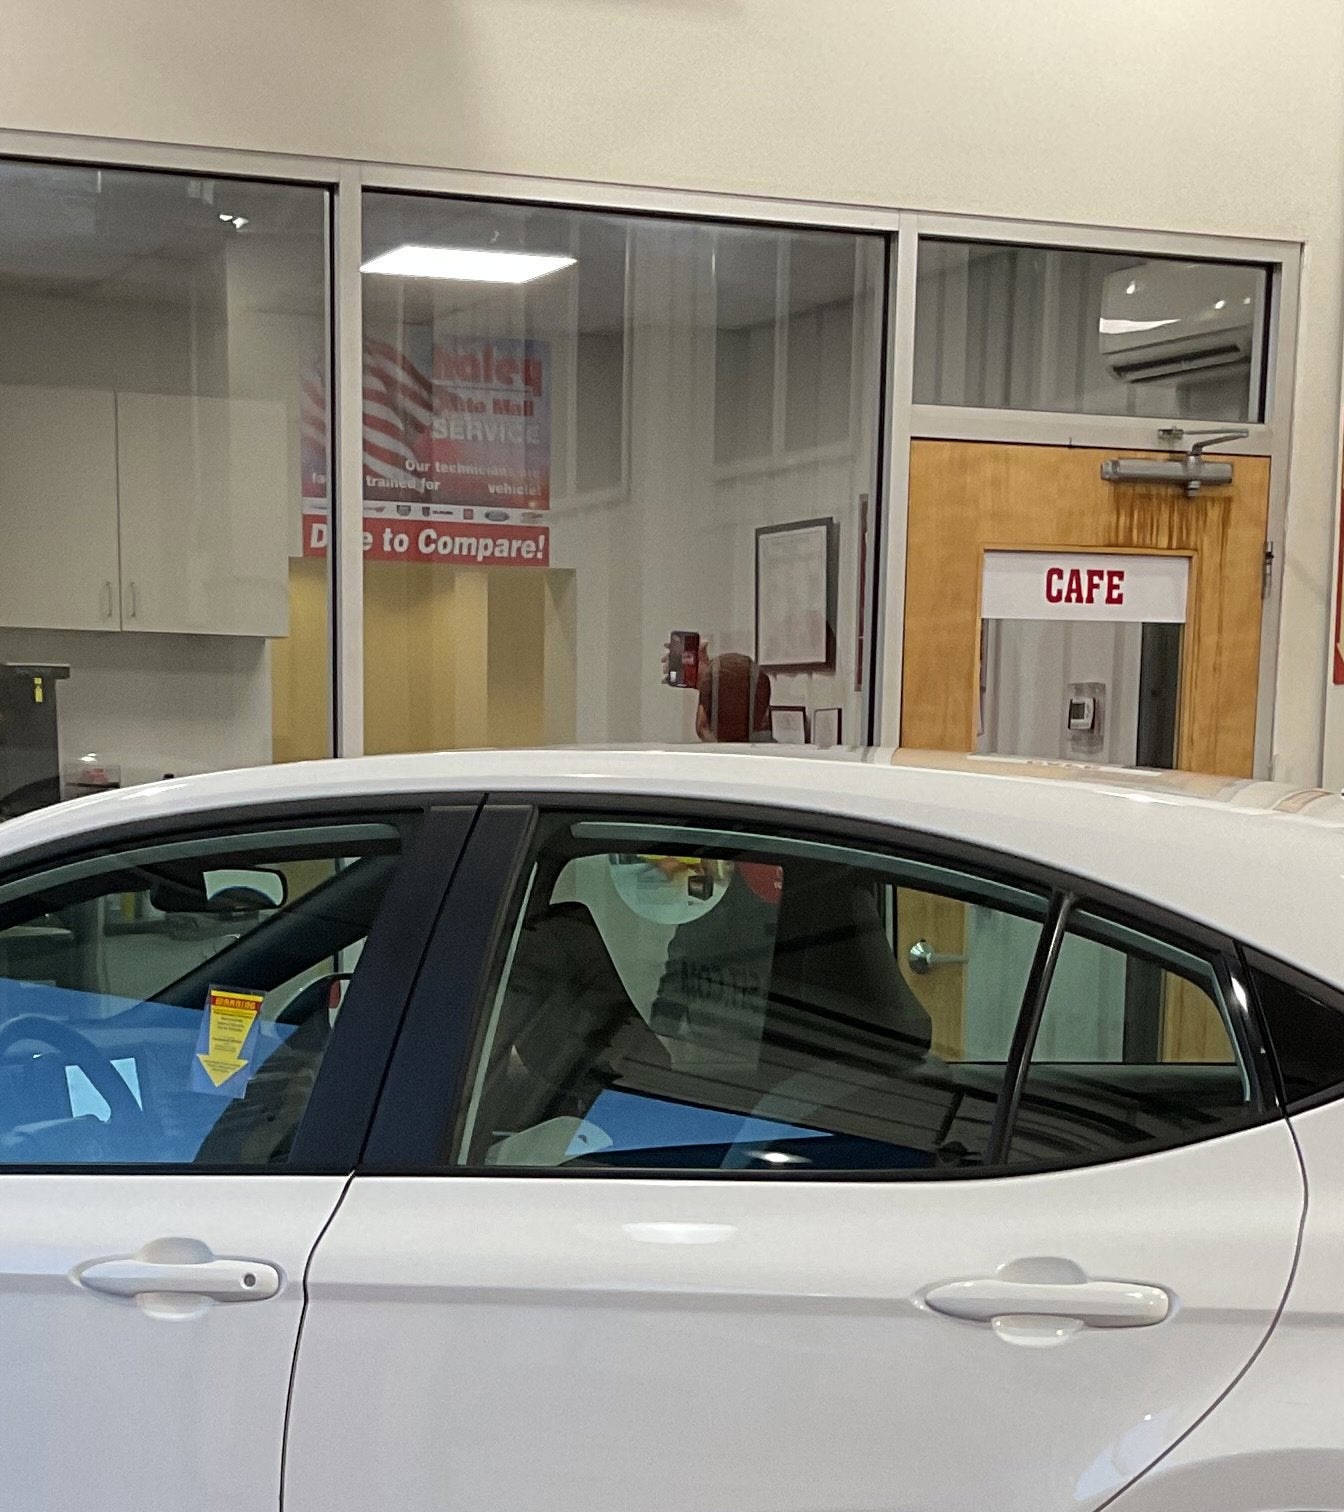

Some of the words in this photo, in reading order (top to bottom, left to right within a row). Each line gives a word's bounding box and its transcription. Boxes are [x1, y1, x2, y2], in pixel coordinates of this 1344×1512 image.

[432, 416, 541, 444] SERVICE
[405, 459, 431, 472] Our
[366, 475, 416, 489] trained
[421, 478, 441, 491] for
[488, 483, 541, 496] vehicle!
[311, 523, 373, 548] De
[383, 528, 409, 552] to
[418, 528, 545, 562] Compare!
[1045, 567, 1124, 605] CAFE
